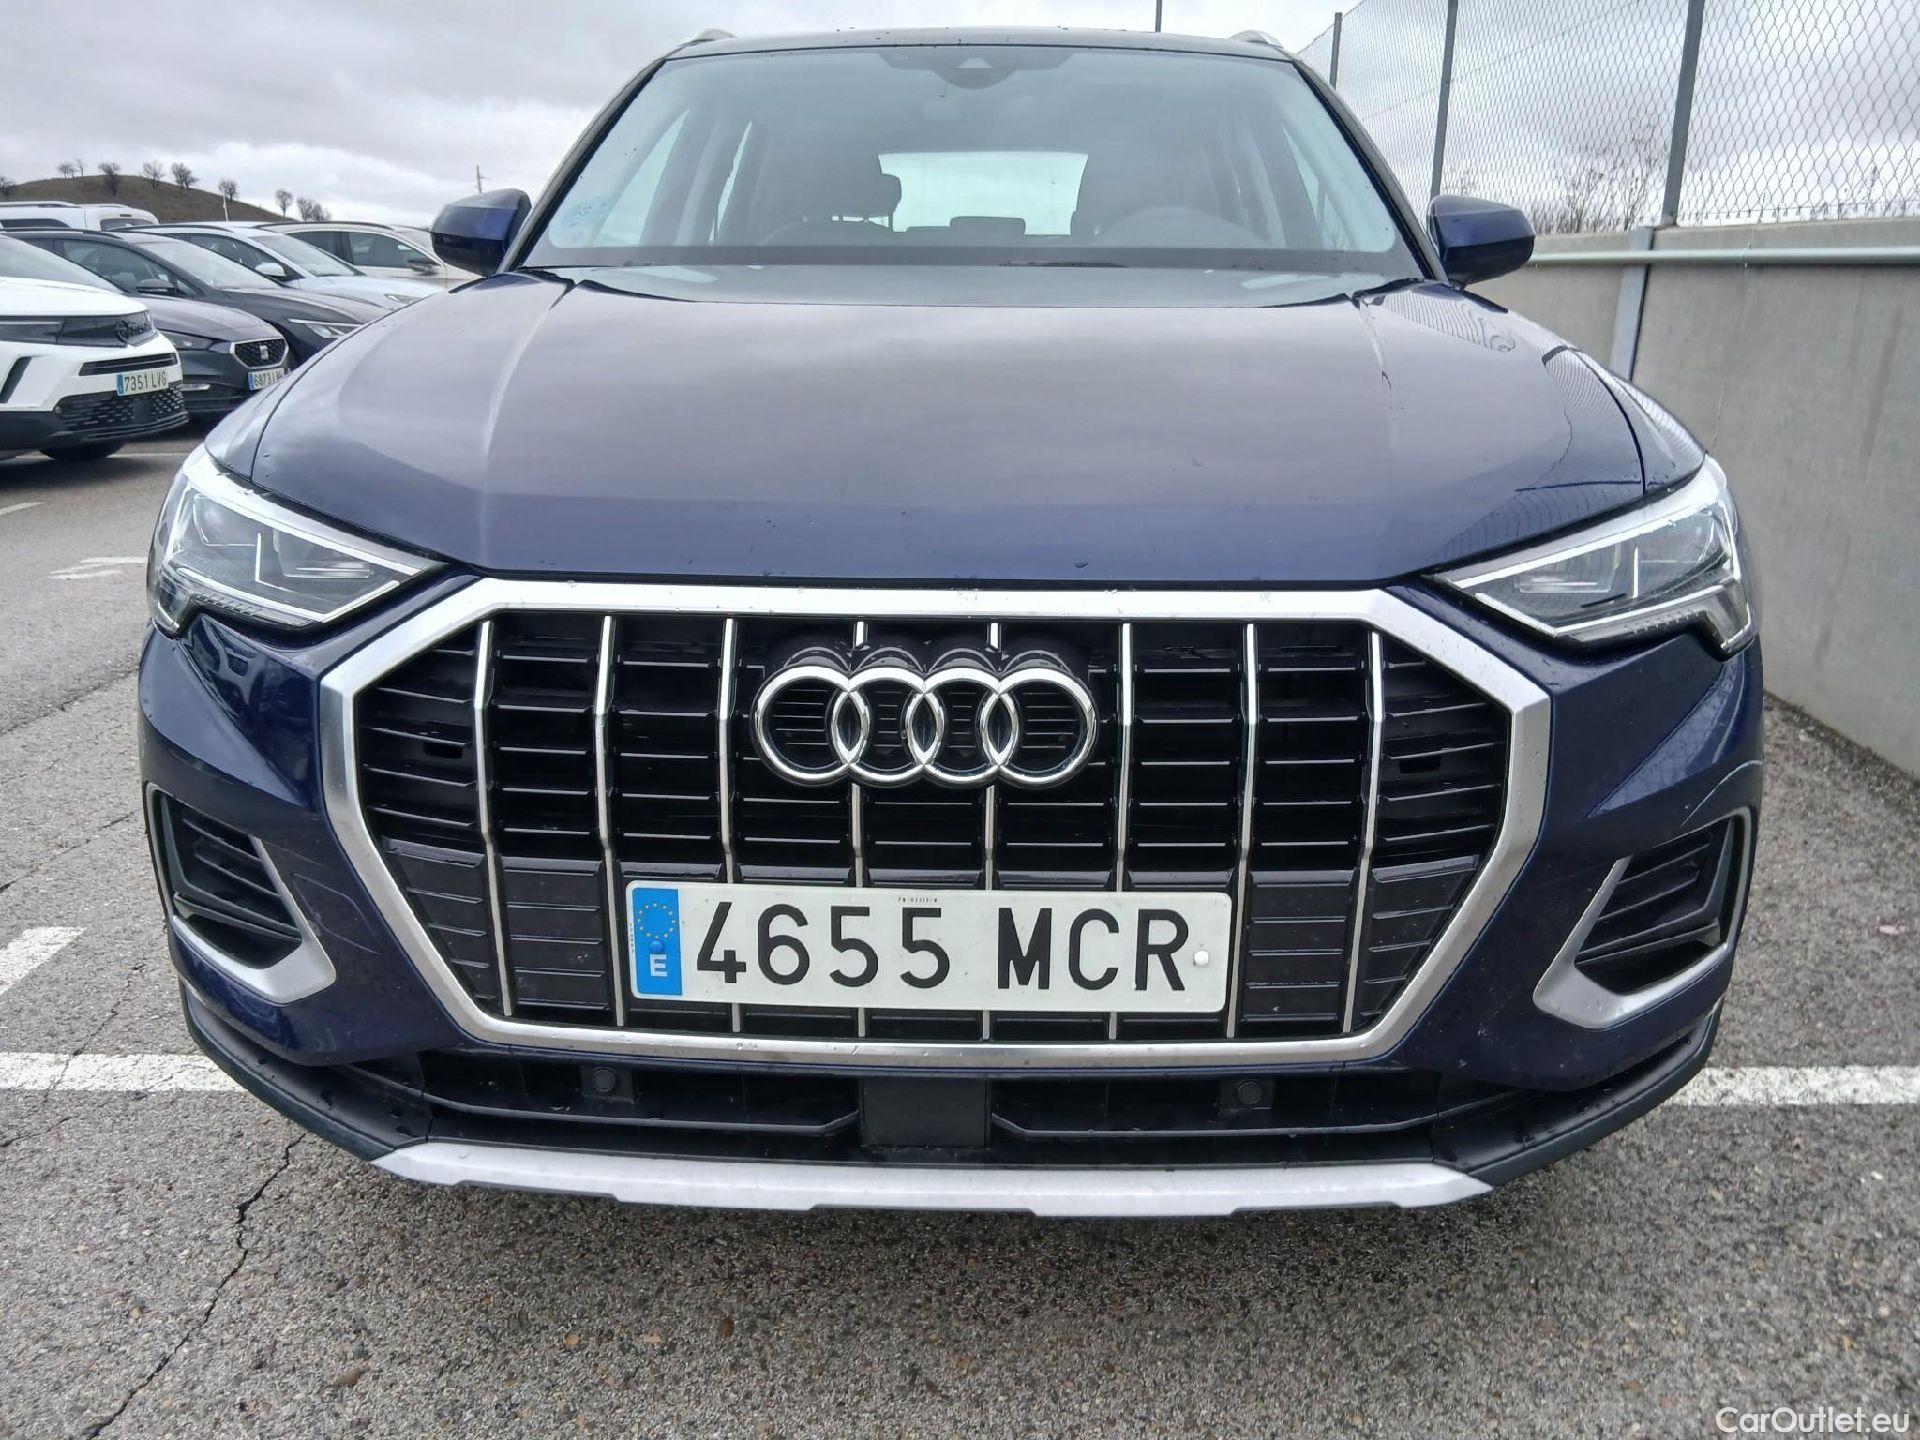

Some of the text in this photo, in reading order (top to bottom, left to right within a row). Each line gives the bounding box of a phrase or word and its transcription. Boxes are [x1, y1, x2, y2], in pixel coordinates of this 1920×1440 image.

[124, 373, 148, 392] 7351
[697, 901, 1189, 992] 4655 MCR
[650, 954, 668, 977] E
